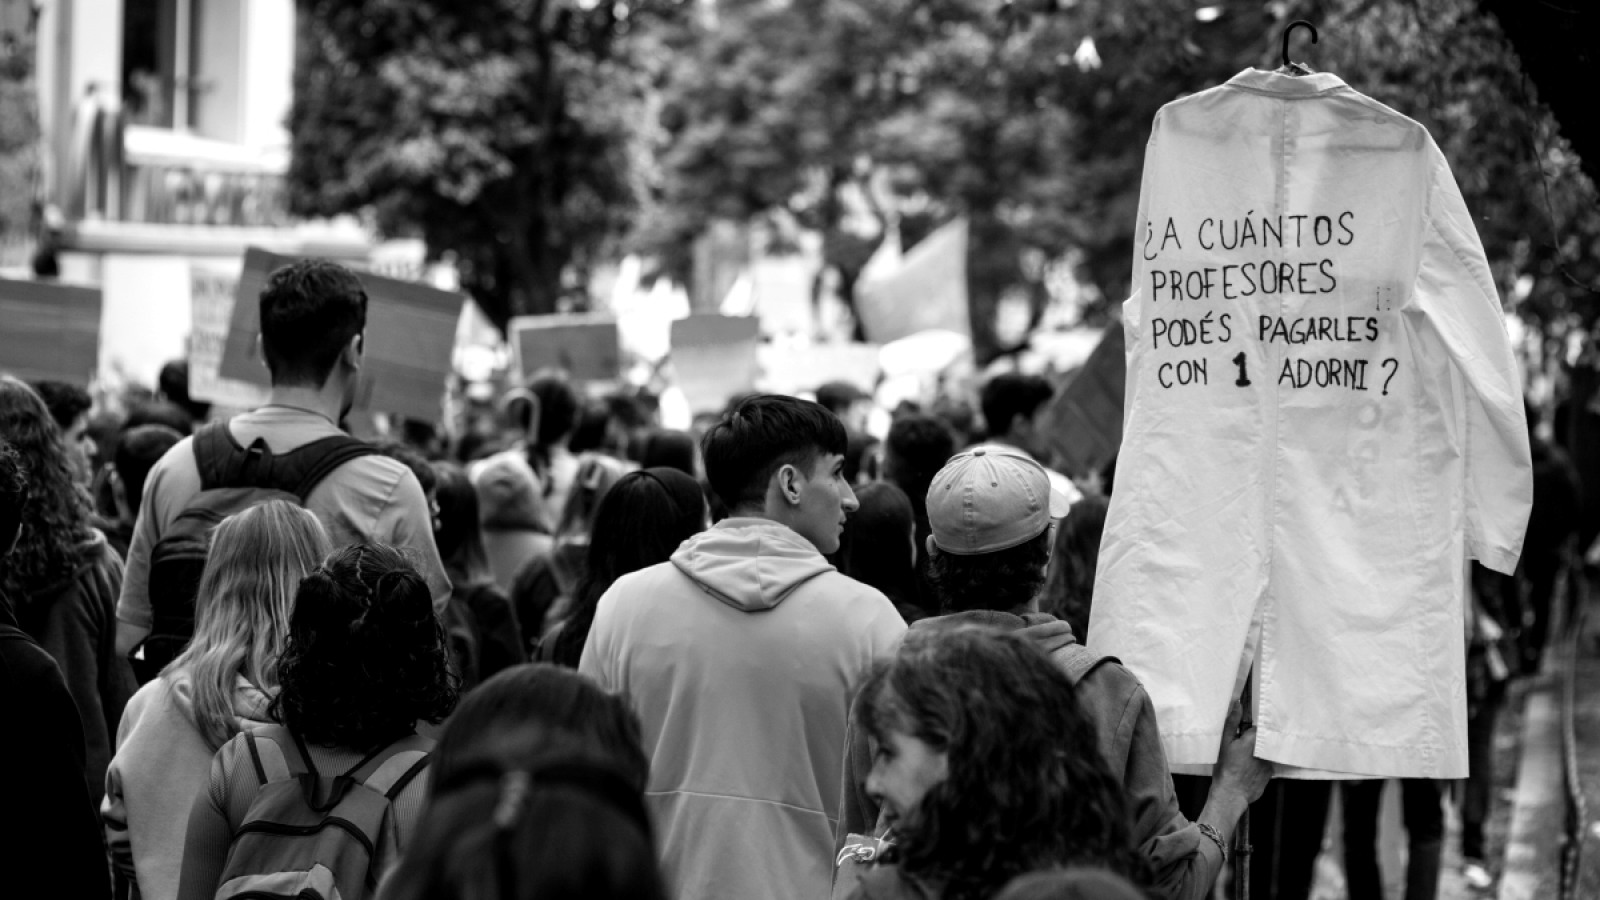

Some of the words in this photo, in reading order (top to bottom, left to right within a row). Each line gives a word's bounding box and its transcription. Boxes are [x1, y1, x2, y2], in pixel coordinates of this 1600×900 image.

[1144, 217, 1181, 260] ¿A
[1198, 210, 1354, 250] CUÁNTOS
[1151, 259, 1336, 302] PROFESORES
[1152, 310, 1231, 349] PODÉS
[1259, 315, 1379, 345] PAGARLES
[1158, 358, 1207, 388] CON
[1232, 352, 1251, 388] 1
[1278, 357, 1368, 390] ADORNI
